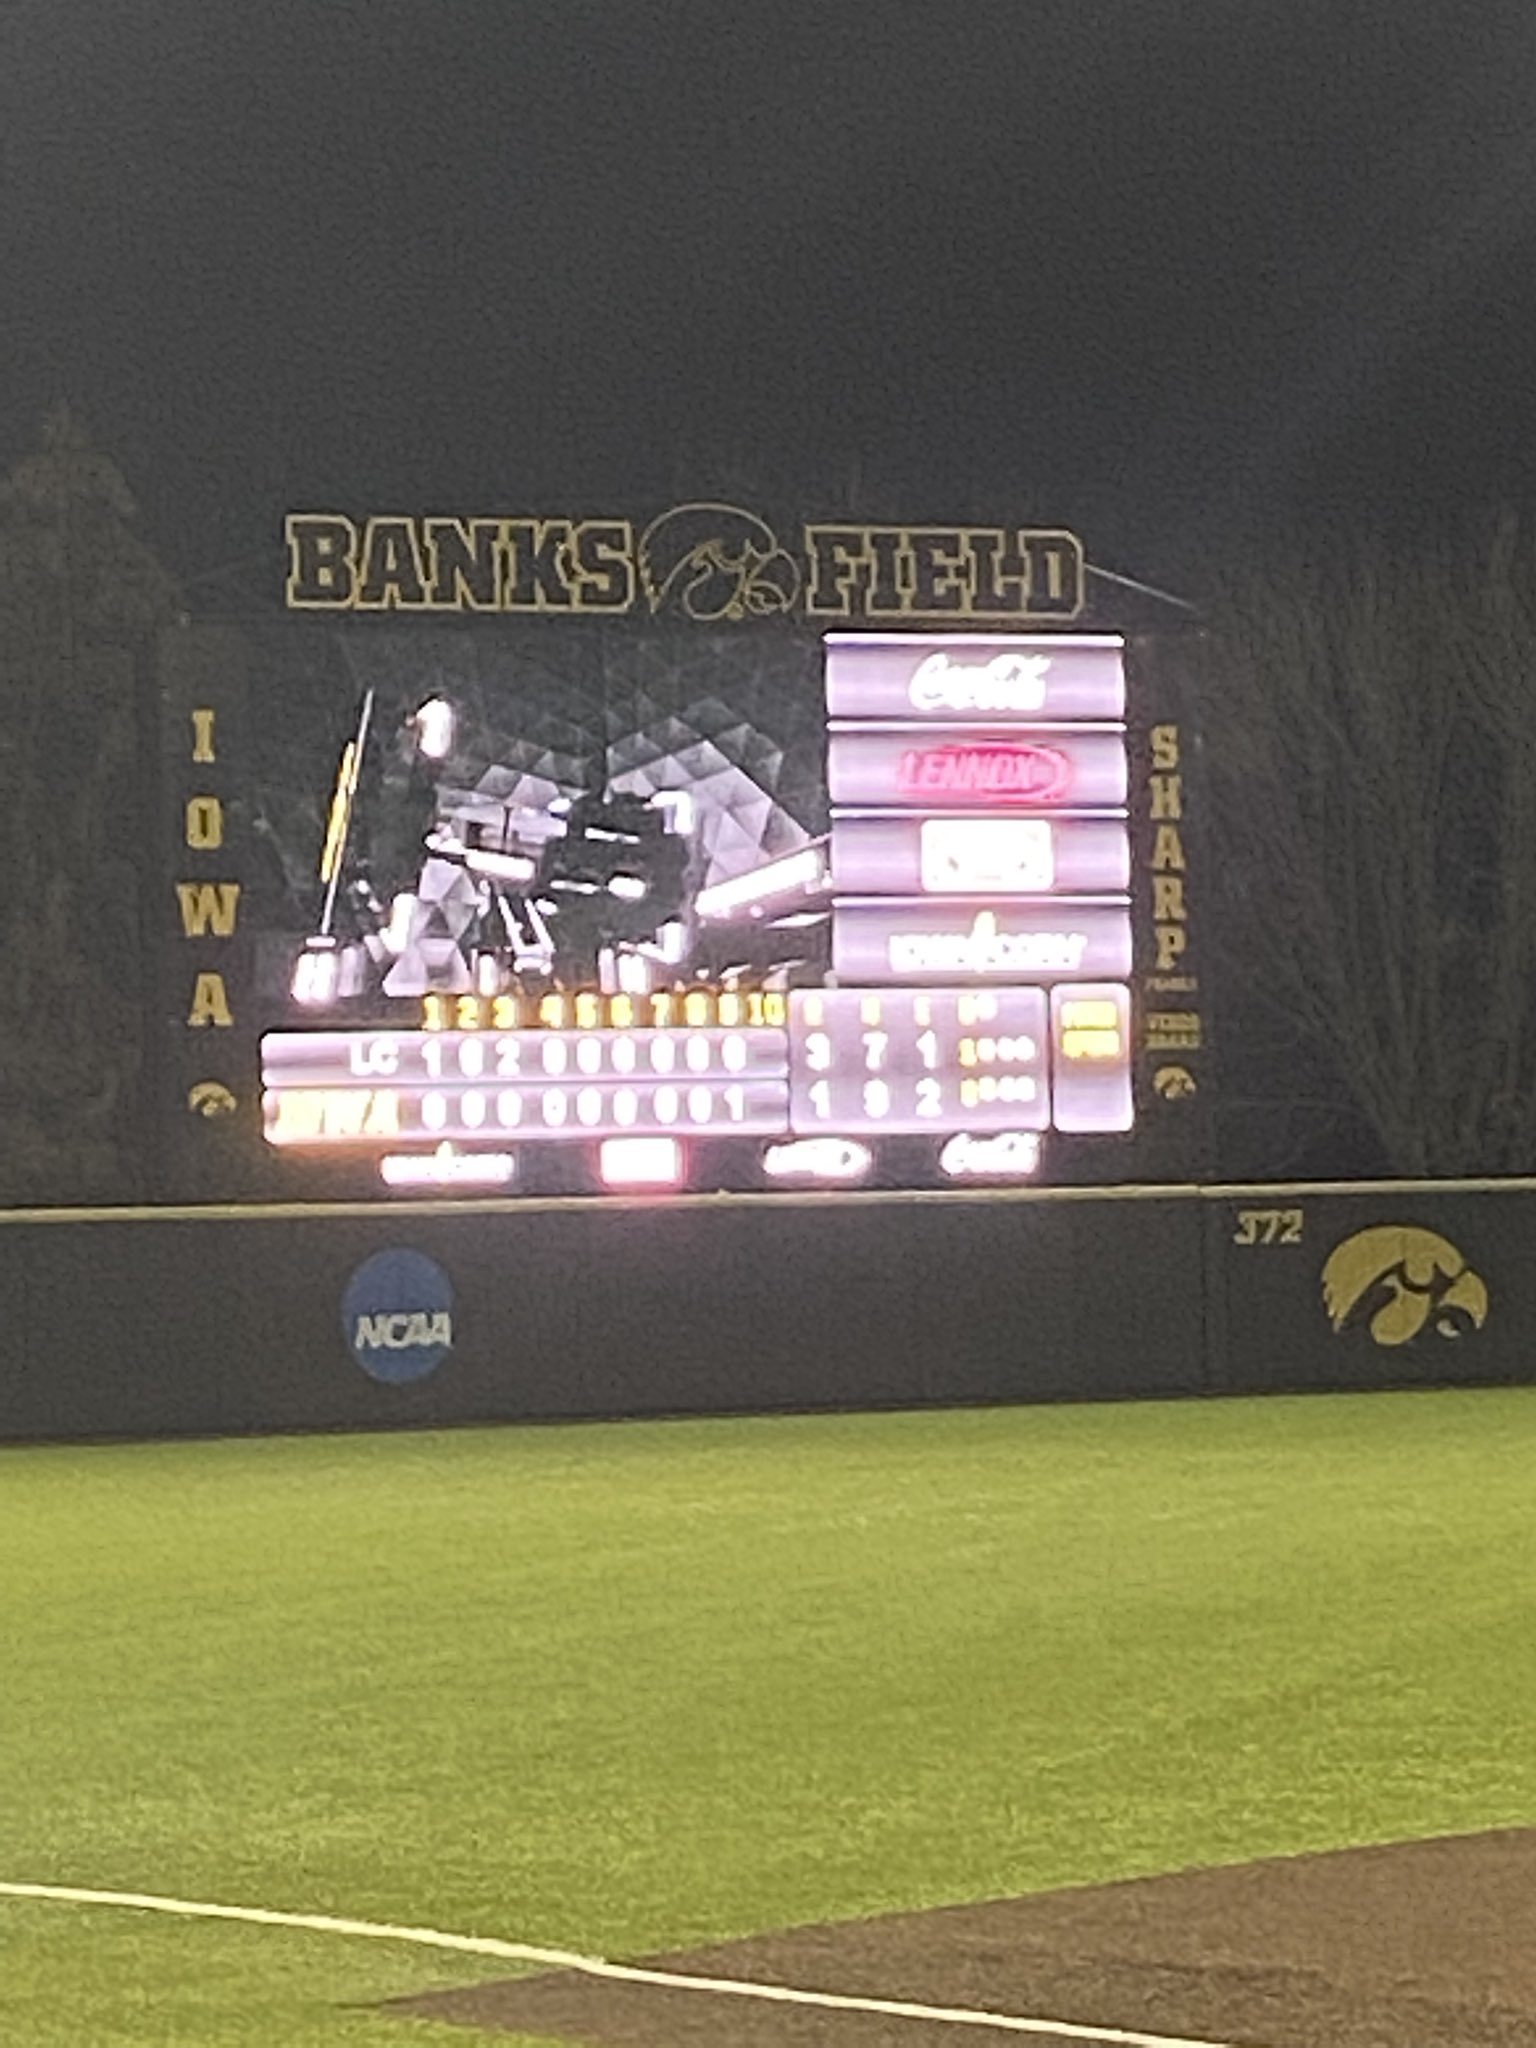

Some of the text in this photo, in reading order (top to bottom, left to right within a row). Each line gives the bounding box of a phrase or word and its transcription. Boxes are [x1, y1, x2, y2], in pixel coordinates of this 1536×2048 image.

[285, 515, 1086, 620] BANKS FIELD
[900, 750, 1036, 791] LENNOX
[1149, 725, 1187, 969] SHARP
[176, 709, 241, 1027] IOWA
[749, 992, 787, 1026] 10
[862, 1031, 887, 1069] 7
[915, 1030, 937, 1069] 1
[809, 1081, 831, 1119] 1
[915, 1078, 942, 1118] 2
[1234, 1209, 1304, 1245] 372
[355, 1312, 452, 1349] NCAA
